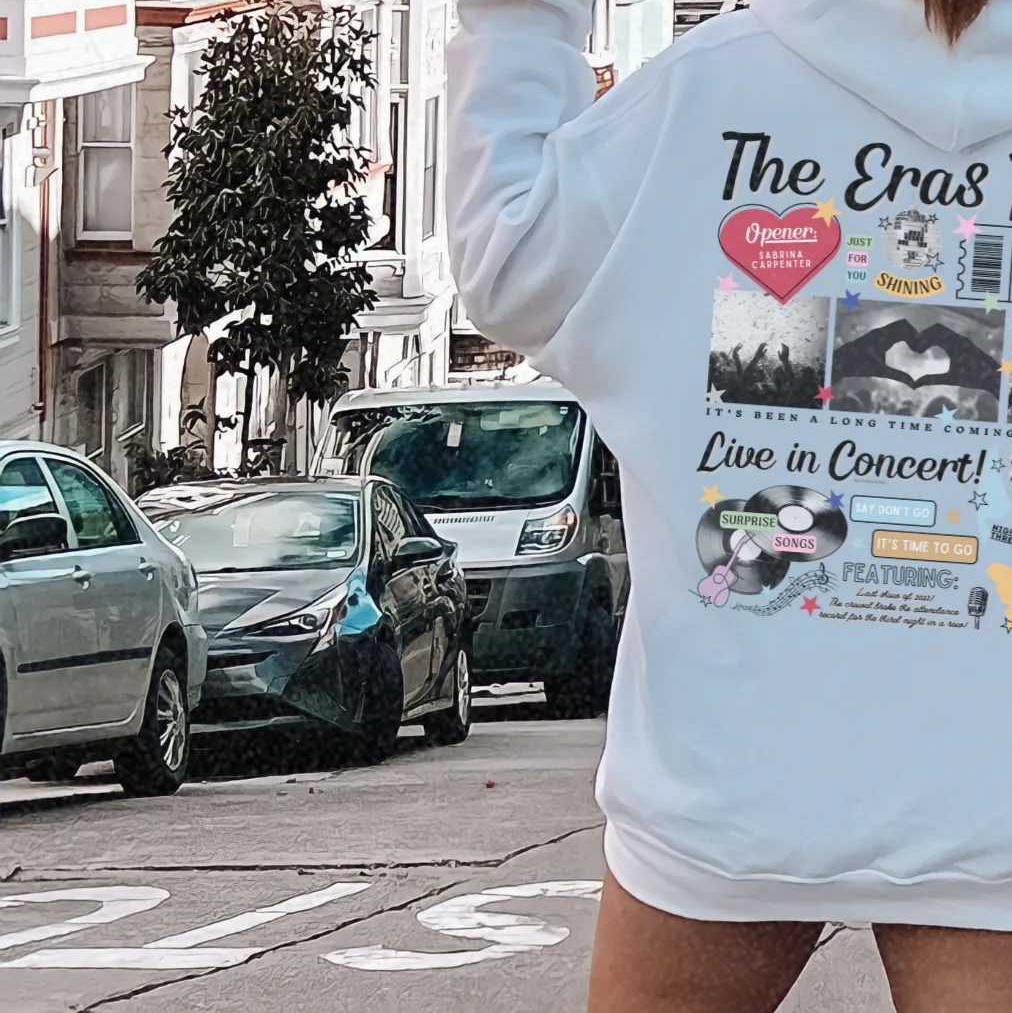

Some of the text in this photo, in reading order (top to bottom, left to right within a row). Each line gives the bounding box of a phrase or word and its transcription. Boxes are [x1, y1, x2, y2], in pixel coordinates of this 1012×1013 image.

[722, 131, 825, 200] The
[844, 142, 989, 211] Eras
[745, 222, 818, 246] Opener:
[846, 237, 873, 247] JUST
[759, 250, 803, 259] SABRINA
[848, 254, 868, 264] FOR
[751, 260, 812, 269] CARPENTER
[847, 271, 866, 281] YOU
[876, 272, 942, 294] SHINING
[706, 408, 742, 418] IT'S
[754, 411, 798, 422] BEEN
[809, 416, 818, 424] A
[830, 416, 876, 428] LONG
[888, 421, 932, 431] TIME
[696, 431, 987, 484] Live in Concert!
[856, 504, 930, 518] SAY DON'T GO
[722, 514, 776, 528] SURPRISE
[774, 537, 815, 550] SONGS
[876, 538, 972, 556] IT'S TIME TO GO
[842, 562, 959, 590] FEATURING:
[856, 588, 936, 602] Last show of 2023!
[829, 597, 960, 616] The crowd broke the attendance
[818, 612, 846, 620] record
[846, 612, 863, 622] for
[864, 614, 877, 622] the
[880, 615, 900, 624] third
[903, 617, 926, 628] night
[948, 620, 969, 628] row!
